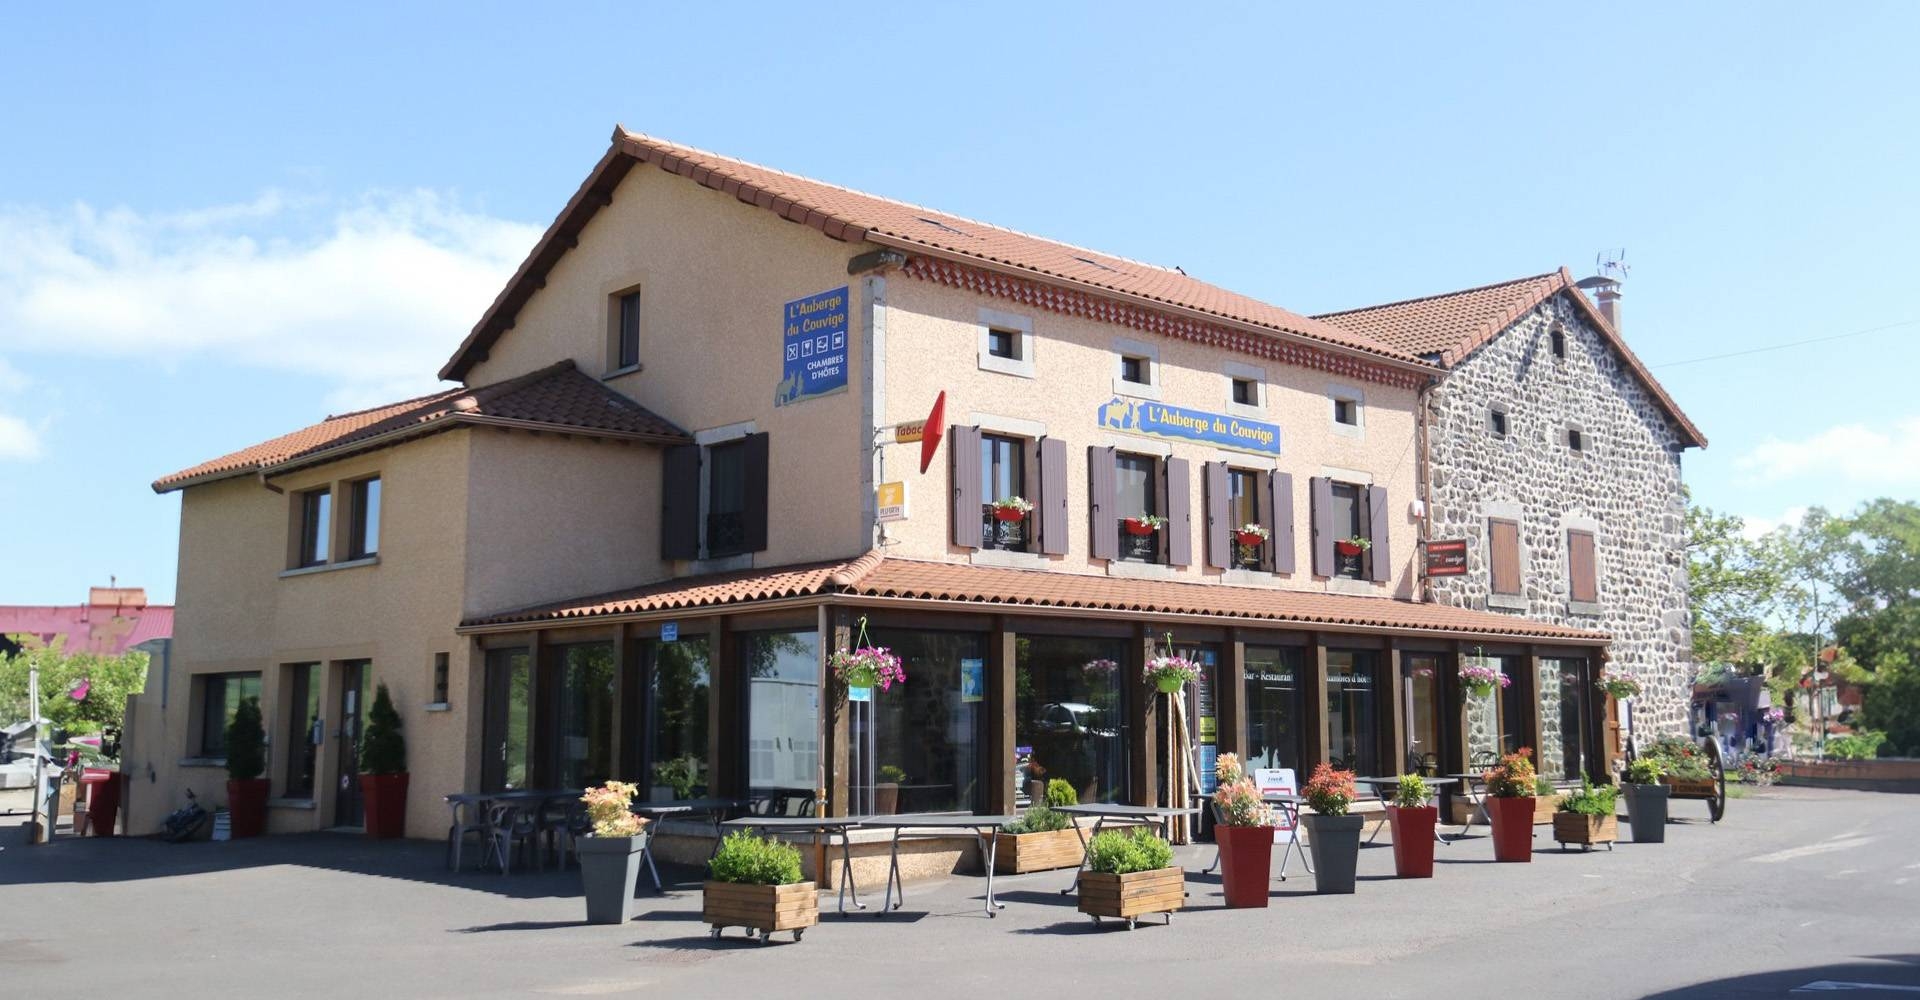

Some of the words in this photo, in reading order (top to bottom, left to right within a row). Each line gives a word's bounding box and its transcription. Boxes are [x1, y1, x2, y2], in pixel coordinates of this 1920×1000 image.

[790, 296, 841, 318] L'Auberge
[787, 323, 799, 336] du
[803, 313, 844, 332] Couvige
[807, 354, 844, 370] CHAMBRES
[811, 366, 839, 380] D'HÔTES
[897, 425, 922, 437] Tabac
[1149, 406, 1208, 433] L'Auberge
[1213, 417, 1227, 433] du
[1230, 420, 1273, 445] Couvige
[1260, 671, 1294, 681] Restaurant
